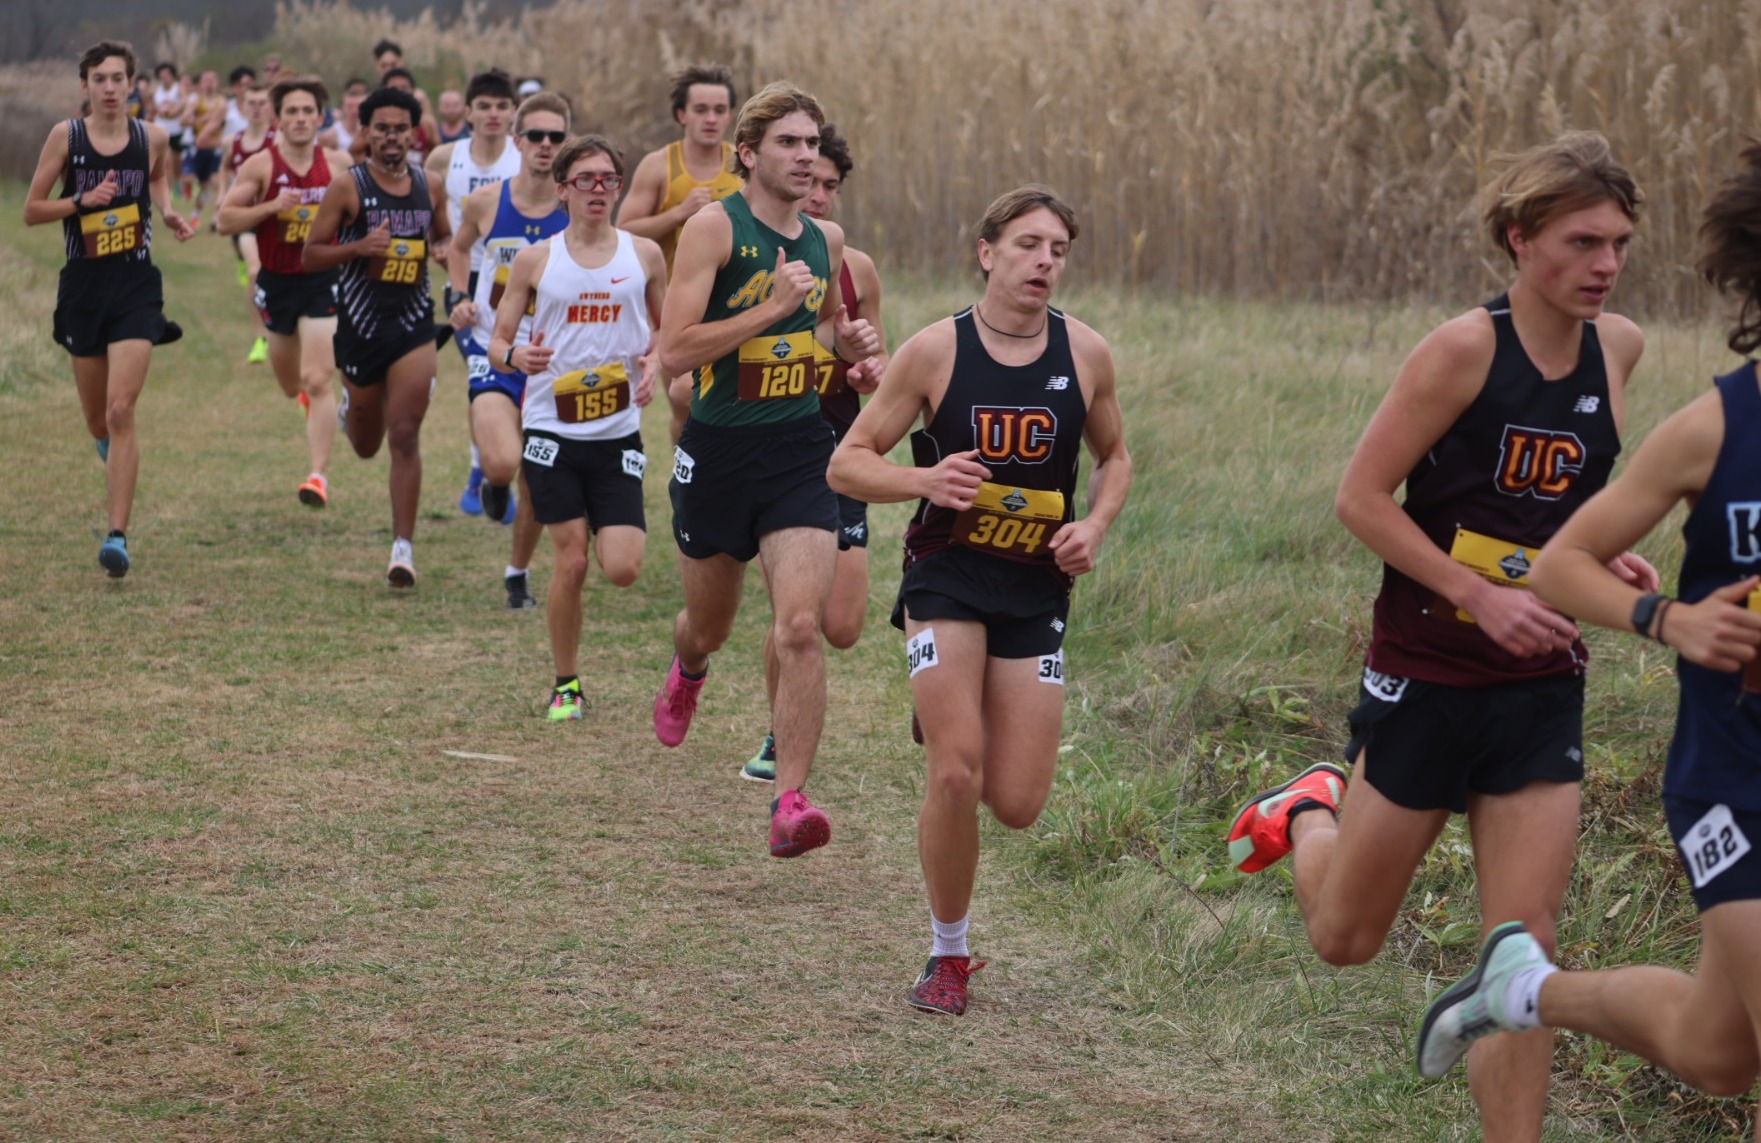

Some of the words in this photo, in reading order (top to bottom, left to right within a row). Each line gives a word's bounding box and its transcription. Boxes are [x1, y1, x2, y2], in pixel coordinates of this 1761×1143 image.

[96, 225, 136, 257] 225
[381, 260, 419, 283] 219
[566, 304, 623, 323] MERCY
[759, 362, 806, 398] 120
[574, 387, 618, 421] 155
[971, 405, 1058, 465] UC
[1494, 423, 1587, 502] UC
[968, 514, 1048, 554] 304
[1693, 824, 1739, 879] 182
